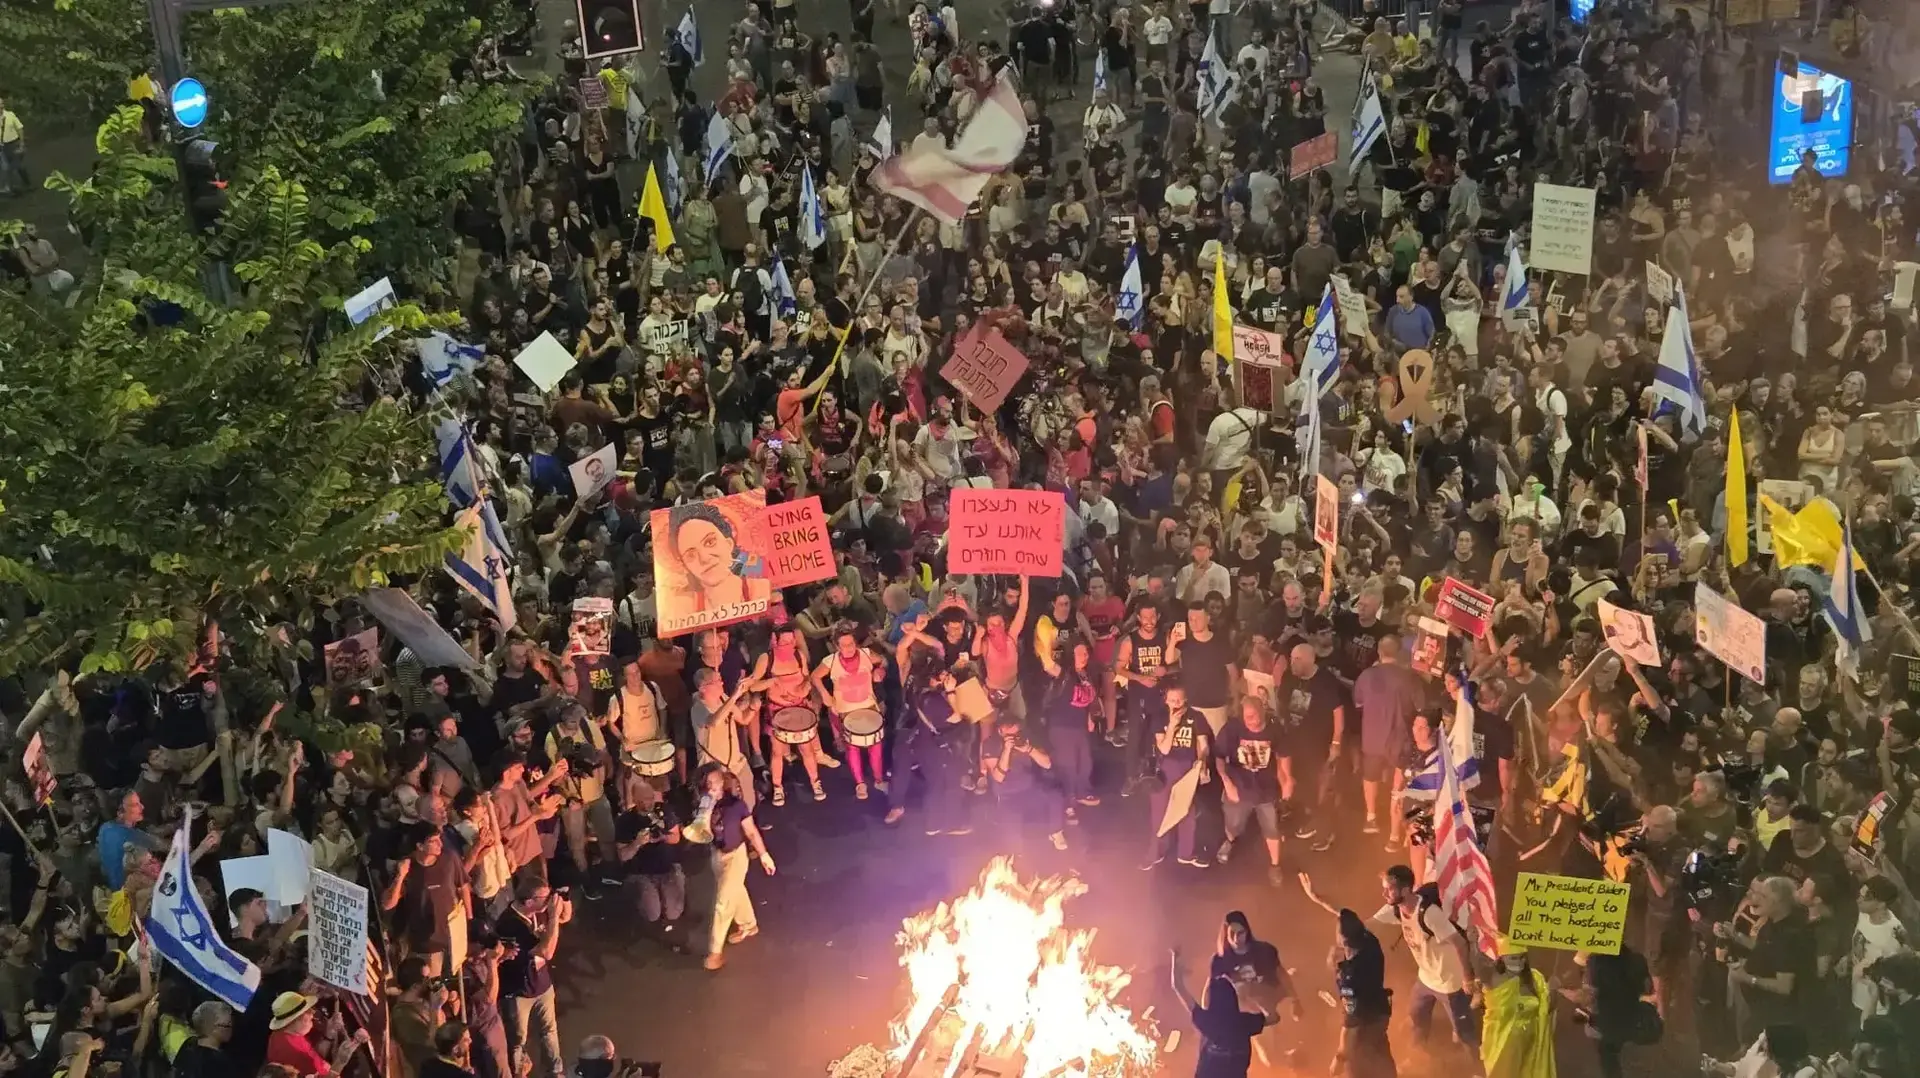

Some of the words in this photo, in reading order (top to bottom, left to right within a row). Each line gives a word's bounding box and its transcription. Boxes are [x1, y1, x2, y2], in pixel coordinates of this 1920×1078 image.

[654, 321, 684, 340] וכמה
[1244, 340, 1270, 352] HERSH
[972, 340, 1008, 376] חובה
[952, 354, 999, 399] להתנגד
[962, 497, 1016, 513] תעצרו
[1028, 498, 1051, 515] לא
[768, 507, 812, 528] LYING
[774, 527, 819, 550] BRING
[963, 523, 988, 538] עד
[998, 524, 1042, 541] אותנו
[779, 550, 826, 574] HOME
[962, 548, 1006, 563] חוזרים
[1015, 551, 1048, 566] שהם
[711, 607, 728, 622] לא
[732, 600, 766, 617] כרמל
[668, 613, 707, 629] תחזור
[1597, 883, 1627, 896] Biden
[1525, 896, 1547, 907] You
[1602, 899, 1618, 913] to
[1516, 910, 1532, 922] all
[1568, 914, 1620, 934] hostages
[1549, 931, 1579, 946] back
[1586, 935, 1616, 947] down
